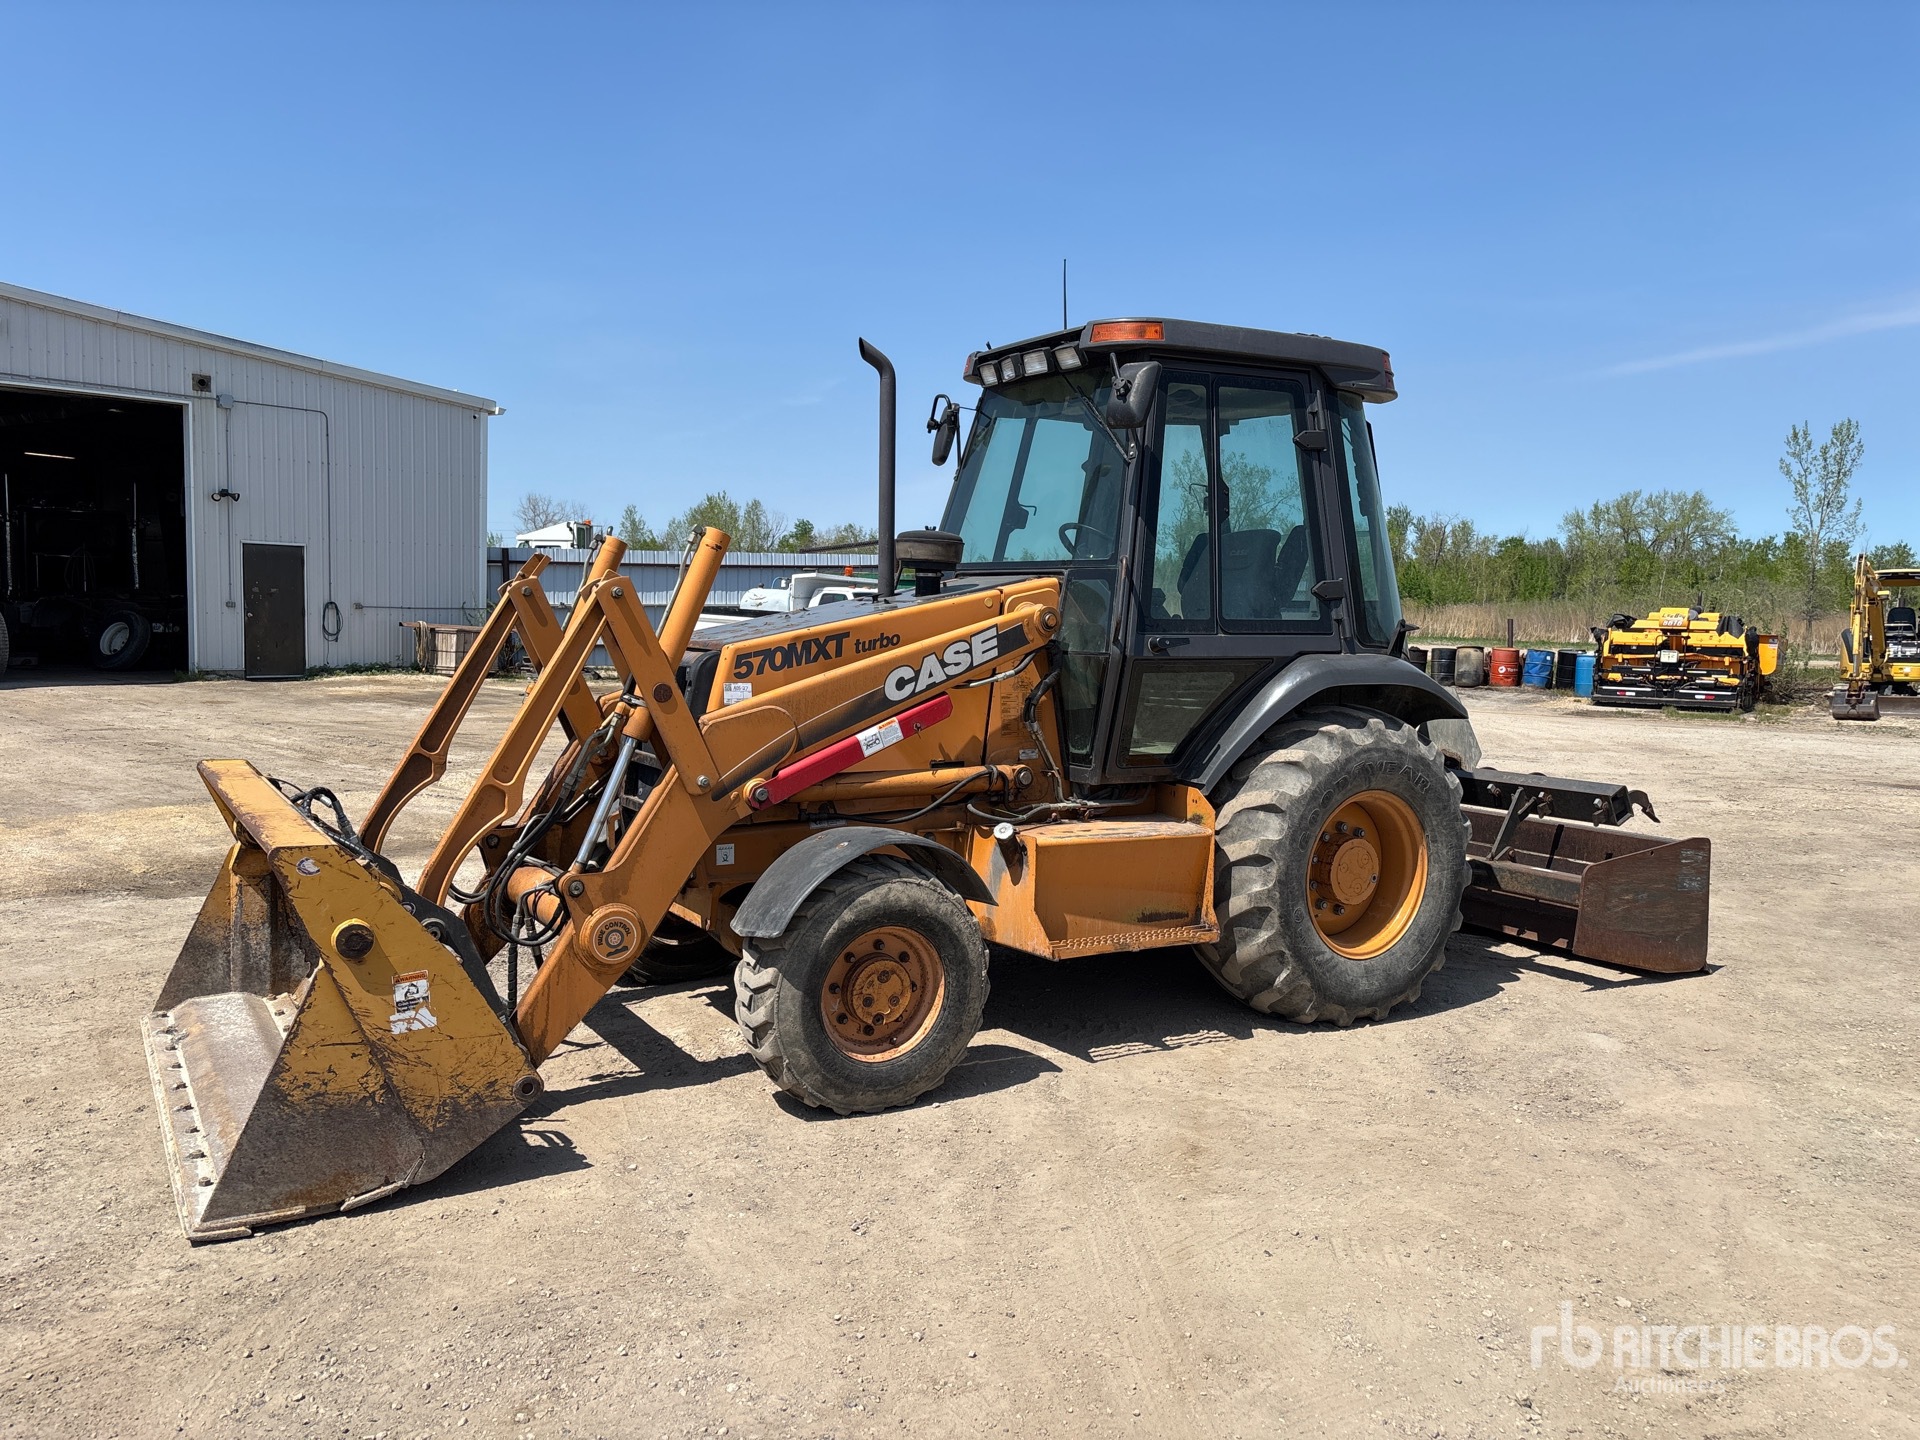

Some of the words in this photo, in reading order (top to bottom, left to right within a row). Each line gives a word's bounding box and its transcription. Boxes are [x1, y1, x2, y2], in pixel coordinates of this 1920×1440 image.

[733, 631, 850, 680] 570MXT
[854, 633, 901, 654] turbo
[883, 625, 999, 702] CASE
[597, 929, 606, 946] RIDE
[604, 921, 631, 937] CONTROL
[400, 973, 426, 983] WARNING
